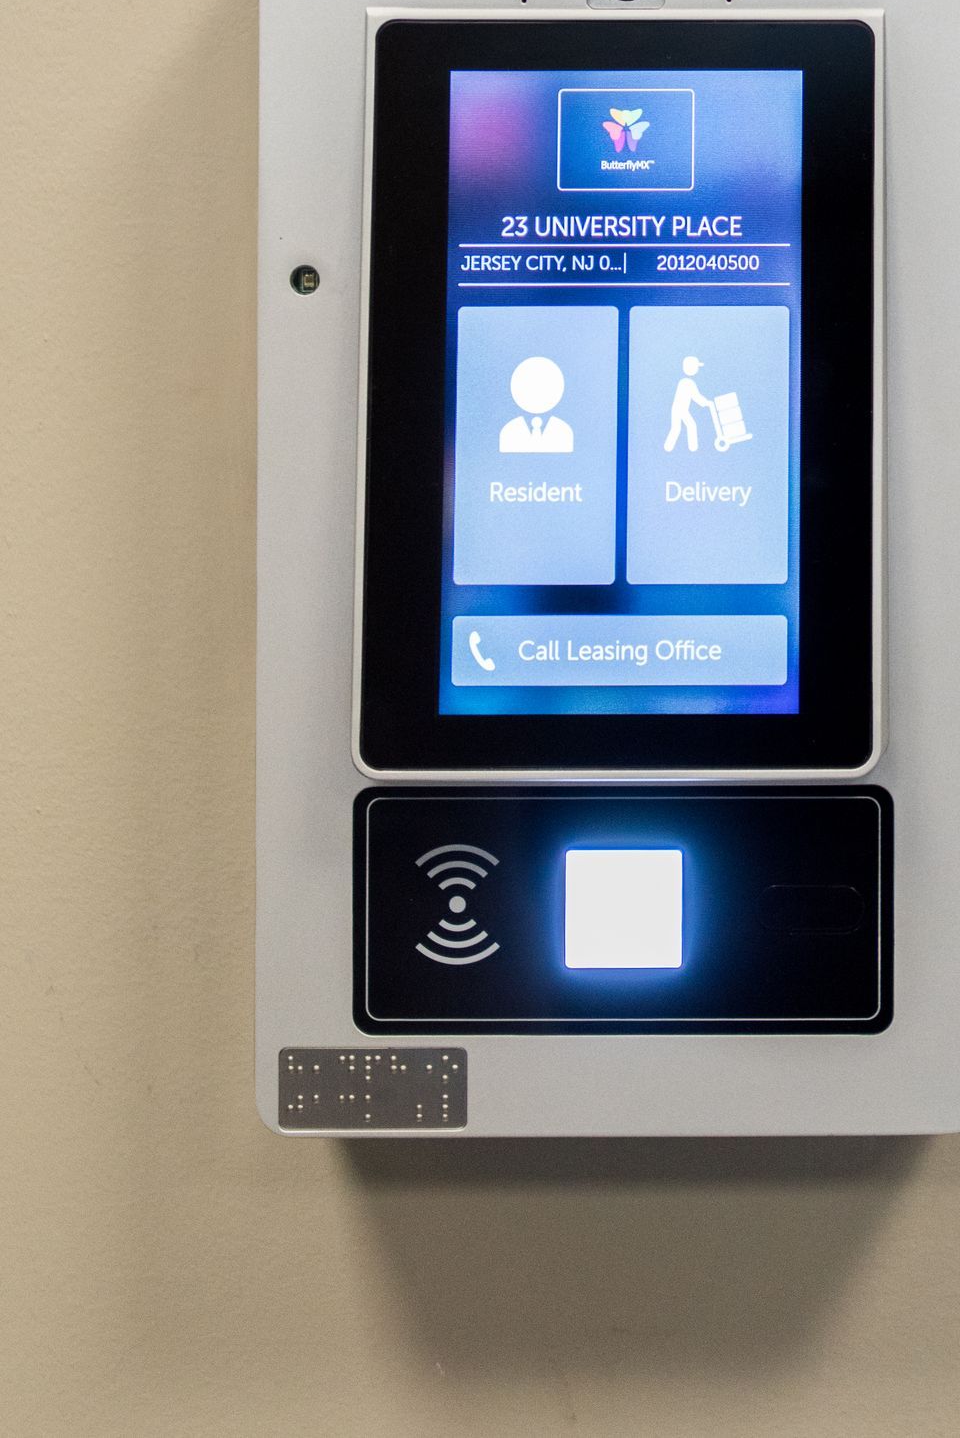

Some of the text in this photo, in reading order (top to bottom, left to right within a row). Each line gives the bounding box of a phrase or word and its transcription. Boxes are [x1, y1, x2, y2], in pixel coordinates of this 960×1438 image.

[501, 216, 743, 237] 23 UNIVERSITY PLACE
[461, 255, 521, 271] JERSEY
[525, 255, 567, 272] CITY,
[572, 255, 594, 270] NJ
[656, 255, 760, 271] 2012040500
[489, 481, 583, 502] Resident
[665, 481, 752, 506] Delivery
[518, 640, 722, 666] Call Leasing Office
